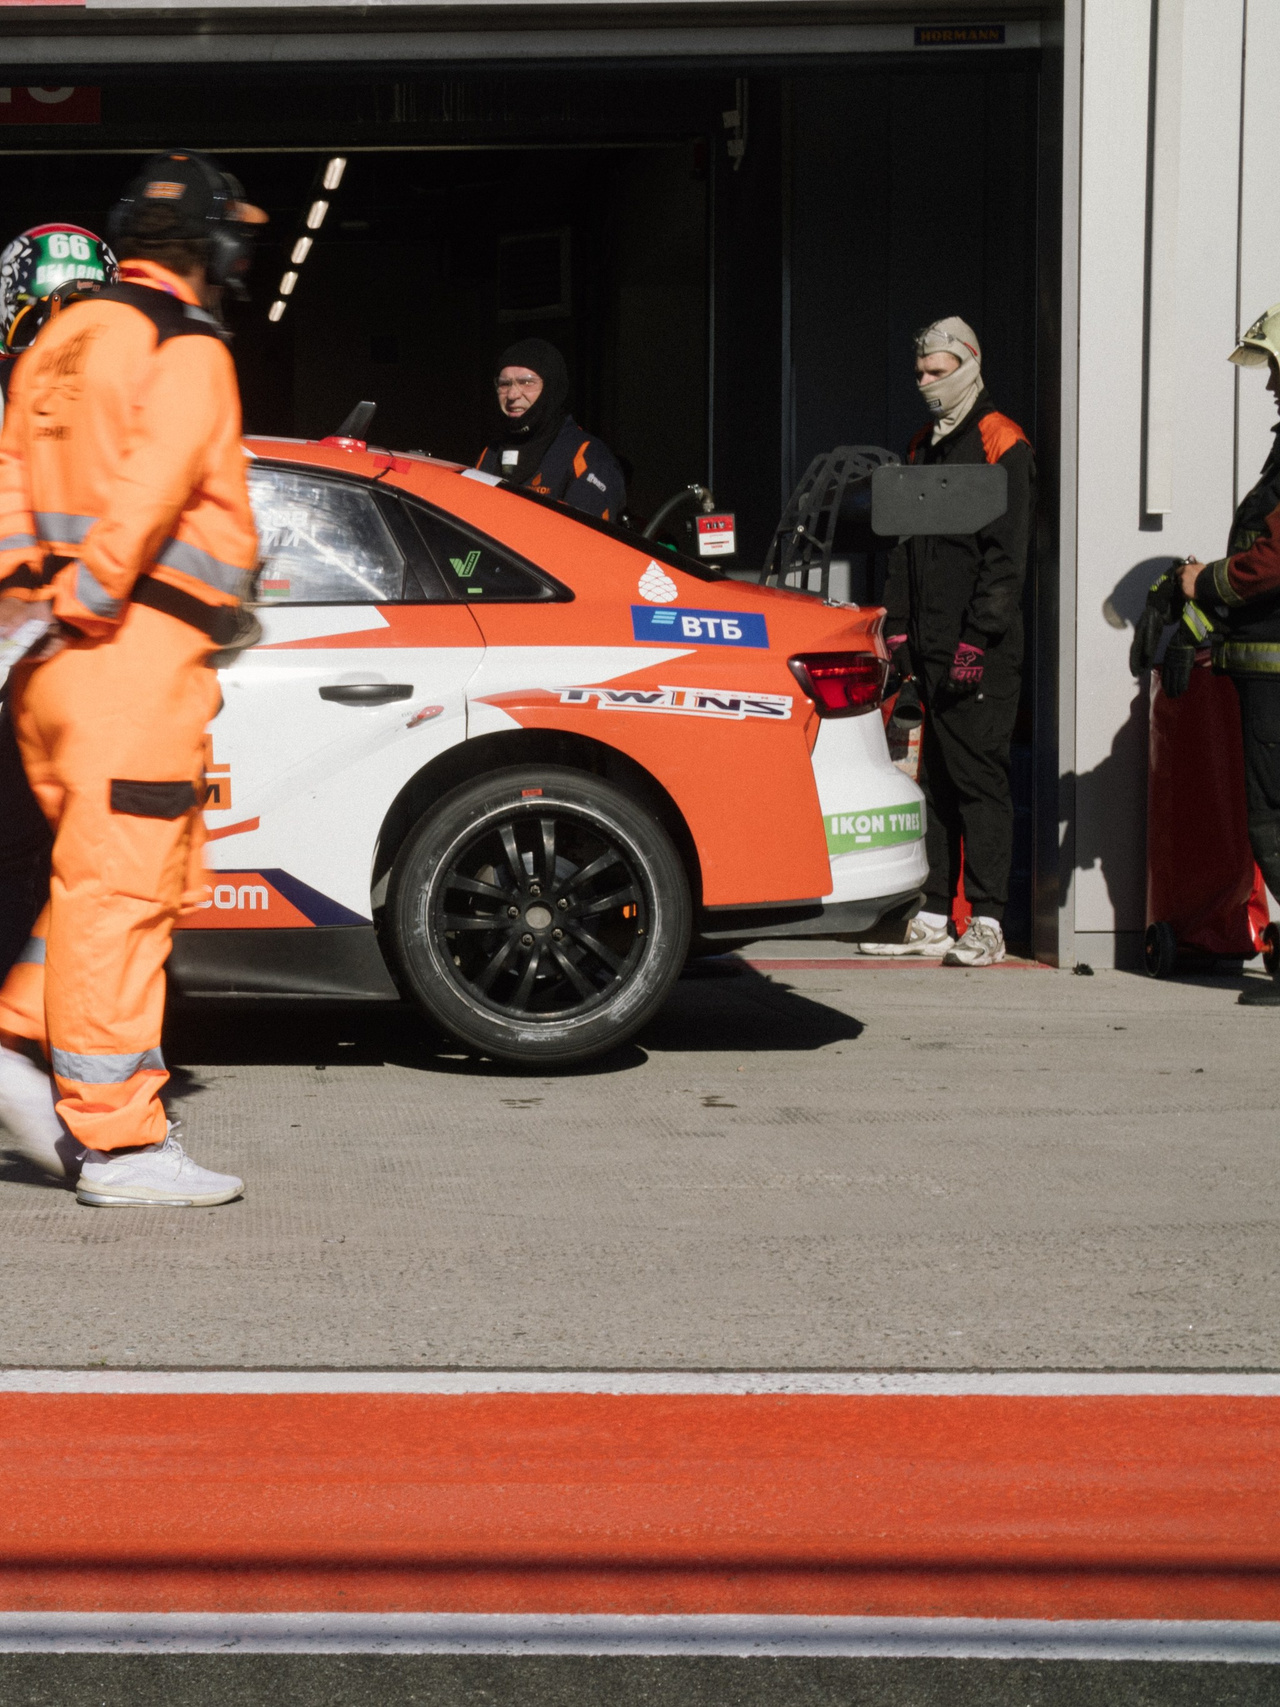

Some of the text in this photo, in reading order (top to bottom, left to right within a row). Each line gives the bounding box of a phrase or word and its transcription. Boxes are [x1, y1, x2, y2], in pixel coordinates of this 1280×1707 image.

[47, 233, 91, 261] 66
[35, 263, 105, 285] BELARUS
[681, 615, 743, 640] ВТБ
[552, 687, 790, 717] TWINS
[831, 812, 920, 835] IKON TYRES
